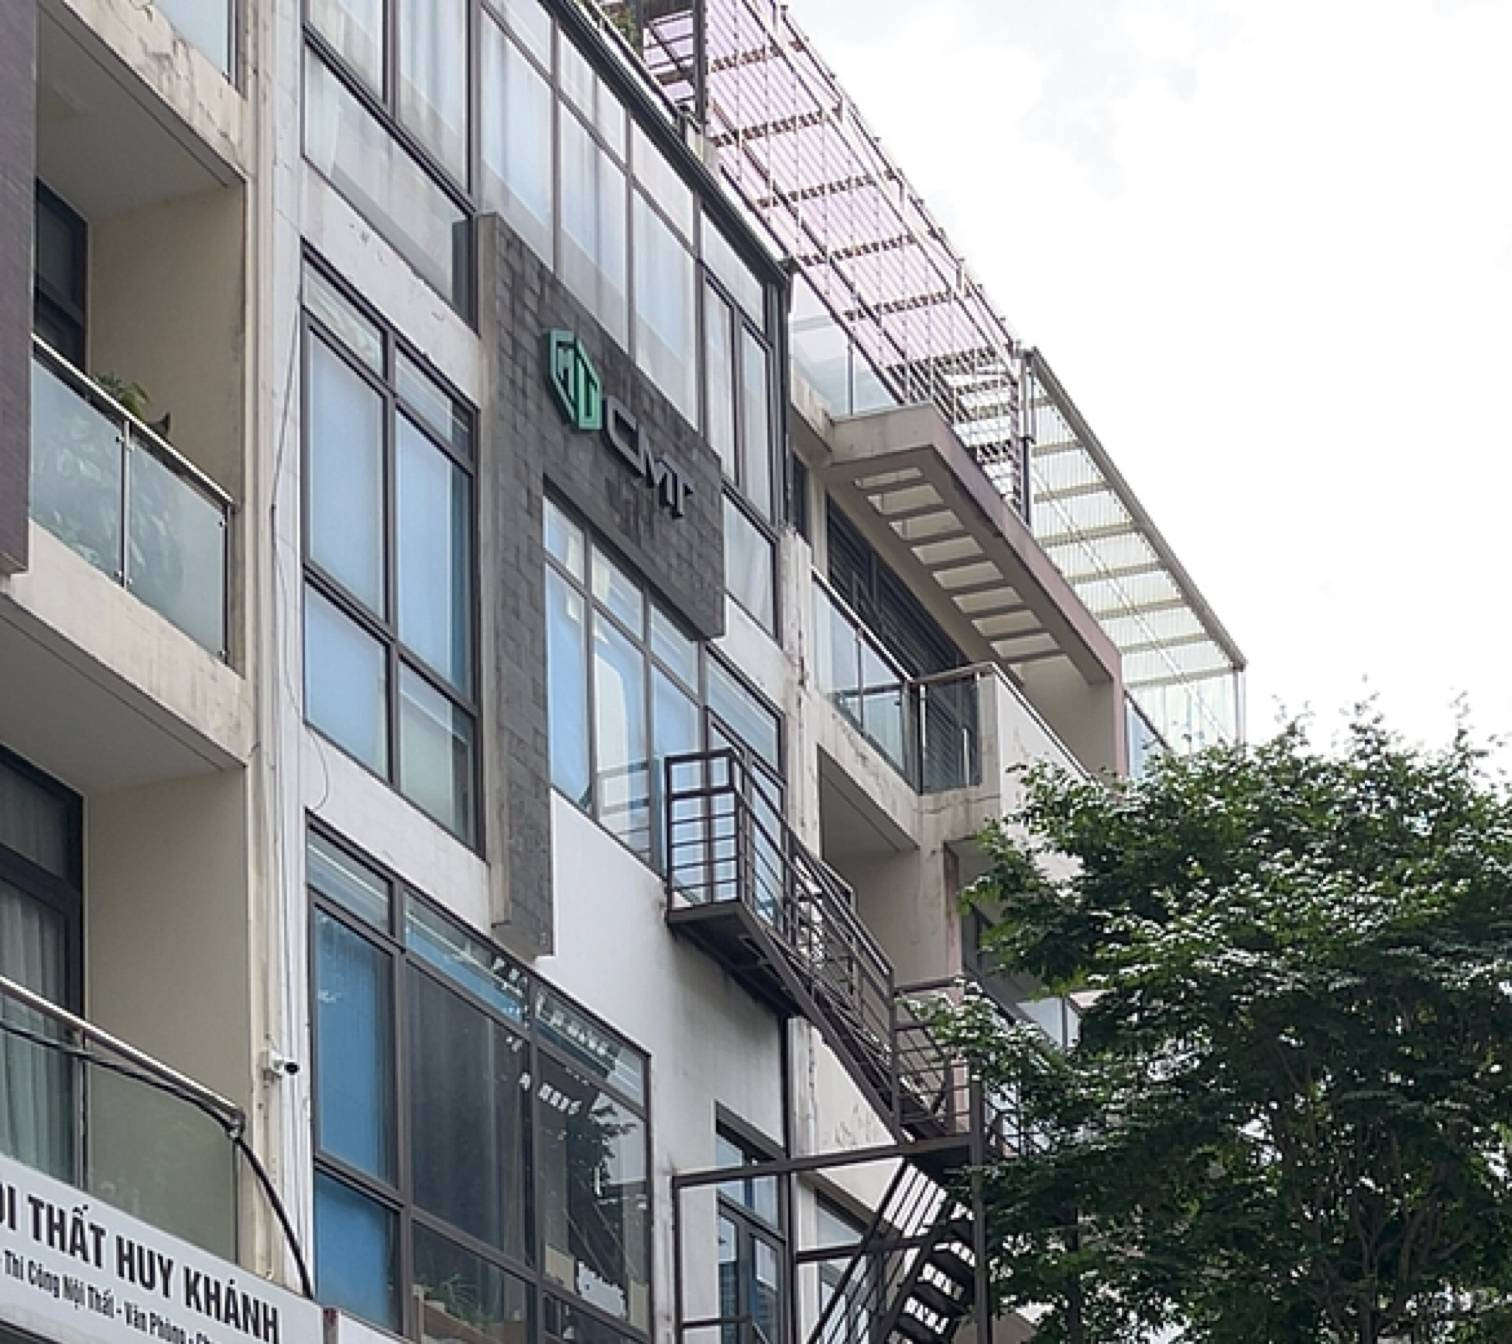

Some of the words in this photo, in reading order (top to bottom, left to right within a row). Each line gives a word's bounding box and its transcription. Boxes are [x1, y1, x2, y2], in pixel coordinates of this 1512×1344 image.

[603, 394, 695, 518] CMT
[28, 1194, 106, 1268] THẤT
[116, 1235, 173, 1298] HUY
